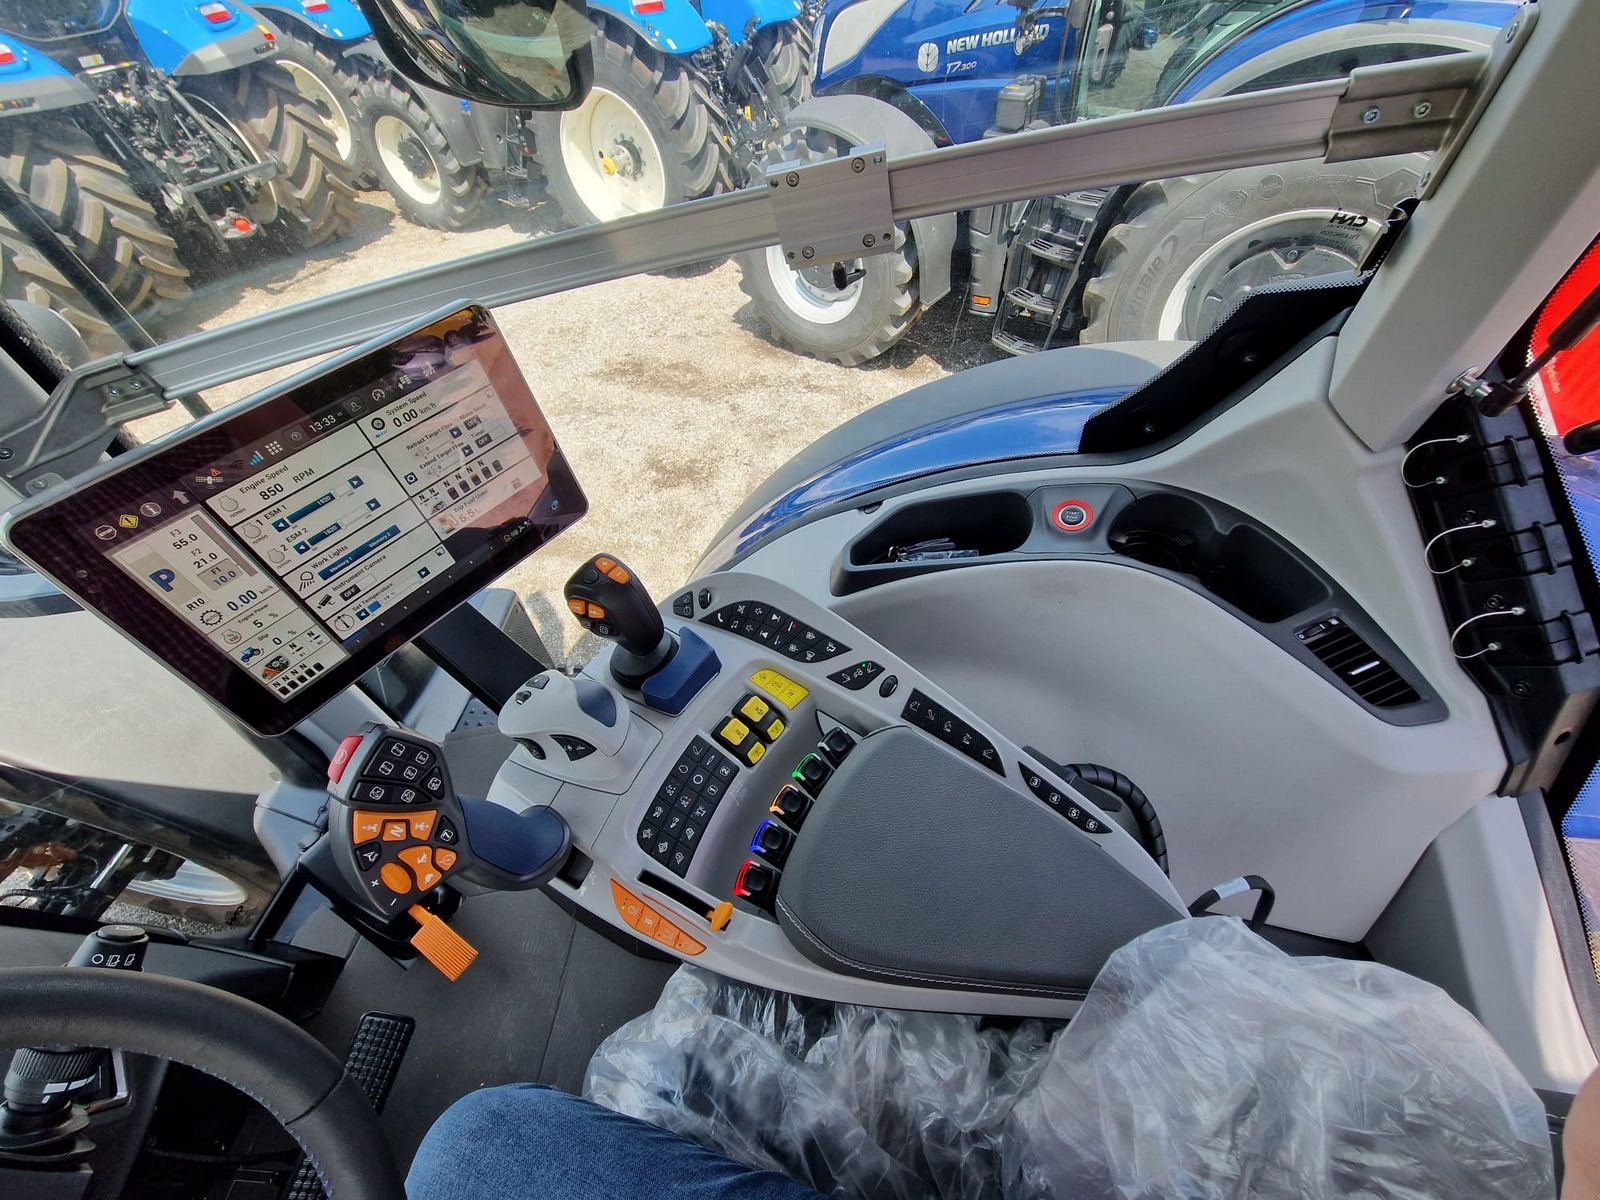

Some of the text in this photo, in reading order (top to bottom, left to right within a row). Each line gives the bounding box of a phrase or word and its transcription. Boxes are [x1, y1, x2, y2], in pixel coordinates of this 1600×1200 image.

[946, 24, 1050, 55] NEW HOLLD
[385, 391, 426, 416] System Speed
[309, 414, 336, 432] 13:33
[392, 402, 436, 427] 0.00 km/h
[406, 437, 425, 450] Retract
[425, 428, 442, 440] Target
[419, 457, 436, 469] Extend
[437, 447, 453, 459] Target
[240, 465, 289, 494] Engine Speed
[259, 468, 314, 500] 850 RPM
[264, 507, 281, 519] ESM
[170, 528, 181, 537] F3
[172, 533, 197, 549] 55.0
[285, 530, 303, 542] ESM
[190, 548, 202, 556] F2
[193, 552, 217, 568] 21.0
[311, 545, 348, 569] Work Lights
[149, 568, 177, 593] P
[213, 570, 236, 585] 10.0
[332, 555, 386, 591] Instrument Camera
[226, 589, 257, 610] 0.00
[343, 587, 356, 597] OFF
[352, 582, 393, 611] Set Temperature
[186, 598, 205, 610] R10
[252, 619, 263, 628] 5
[271, 637, 282, 645] 0
